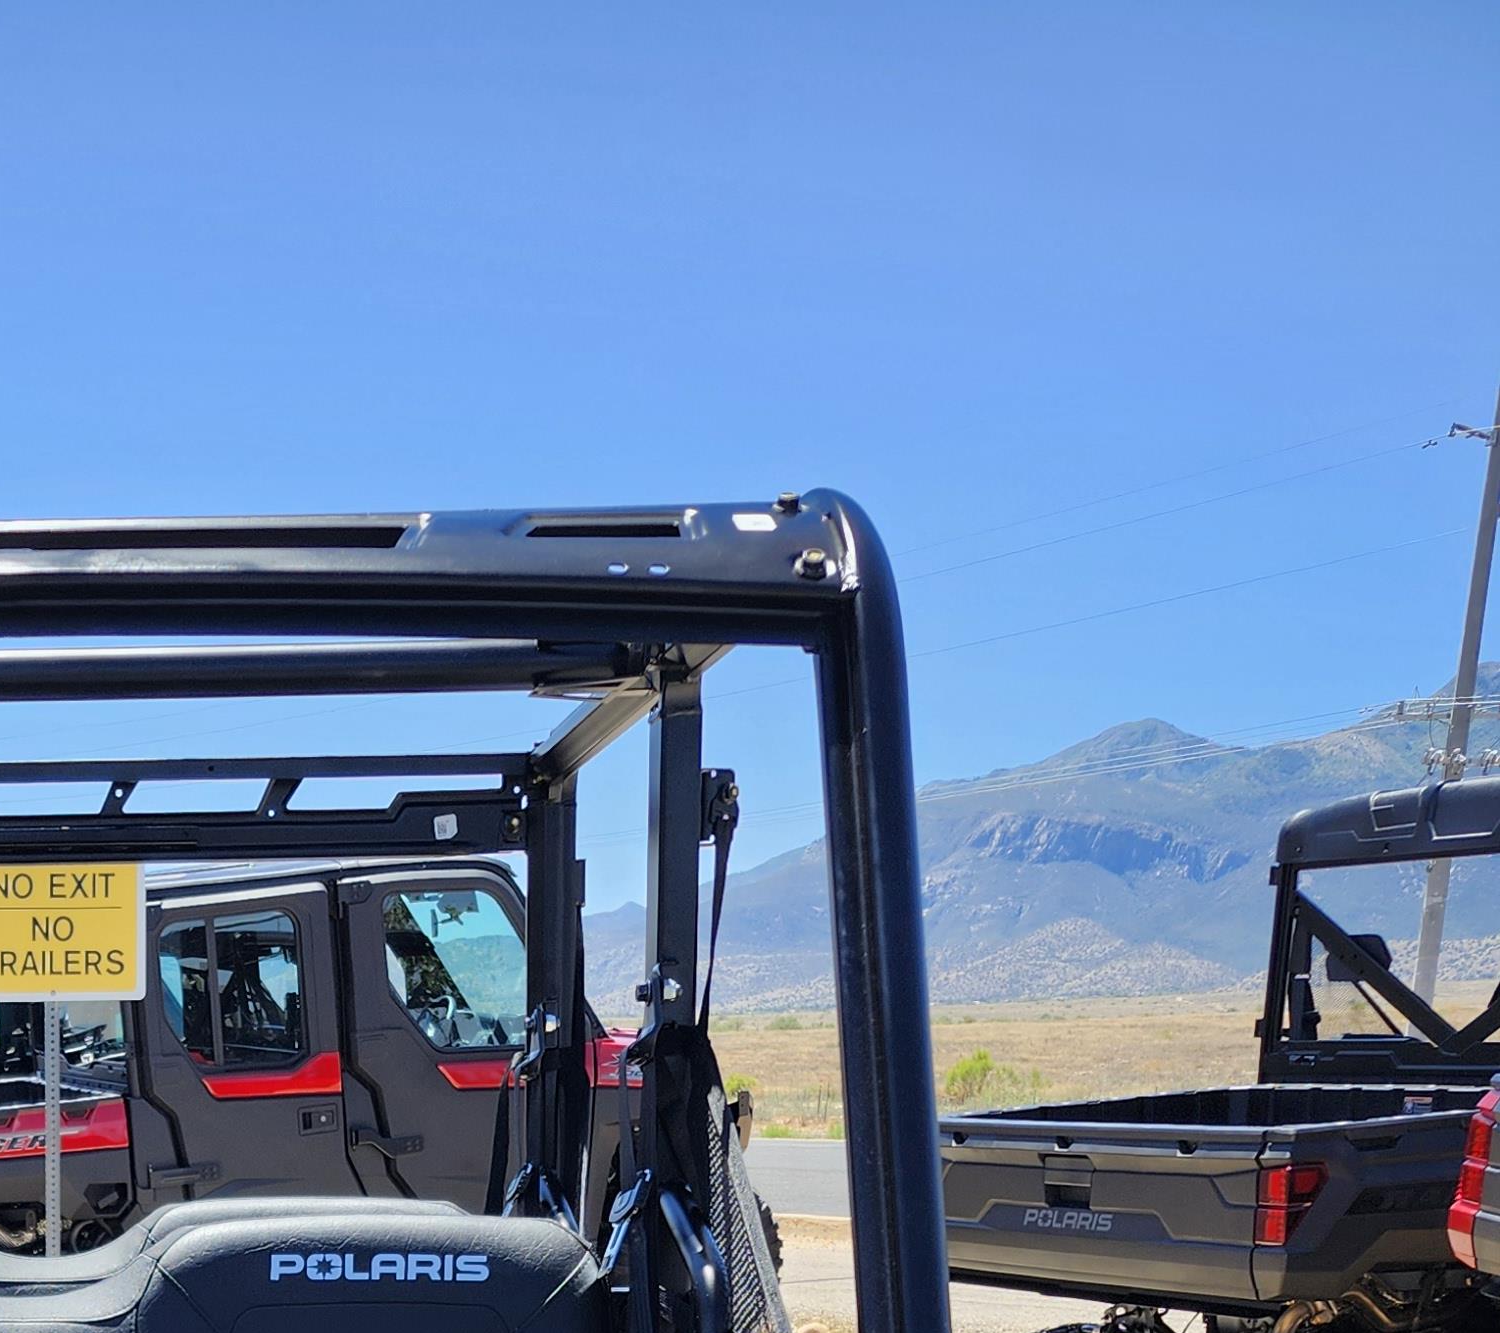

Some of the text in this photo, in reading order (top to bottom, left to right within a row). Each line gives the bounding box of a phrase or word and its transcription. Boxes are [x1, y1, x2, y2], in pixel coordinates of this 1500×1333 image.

[49, 873, 116, 899] EXIT
[31, 916, 75, 942] NO
[1023, 1208, 1114, 1232] POLARIS
[269, 1253, 490, 1282] POLARIS
